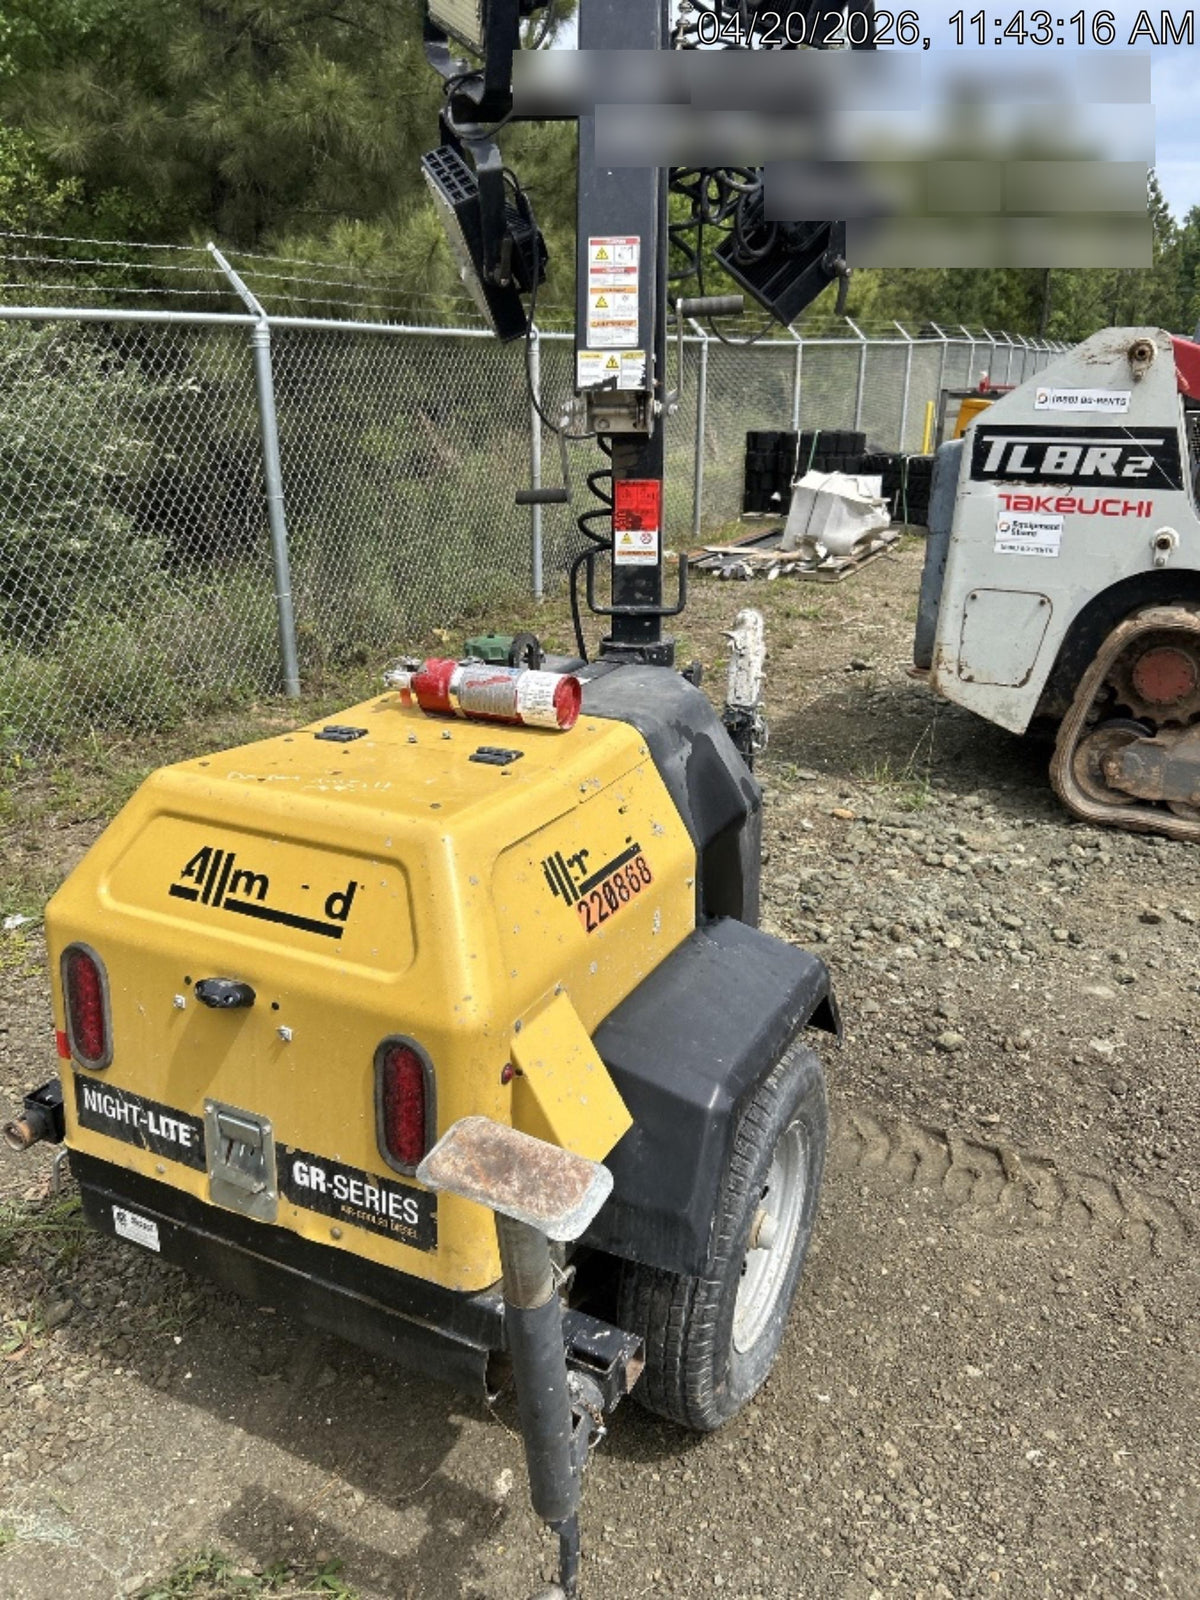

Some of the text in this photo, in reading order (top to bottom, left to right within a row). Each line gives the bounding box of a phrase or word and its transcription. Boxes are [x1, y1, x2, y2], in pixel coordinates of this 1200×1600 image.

[982, 435, 1165, 478] TL8R2
[577, 856, 652, 934] 220868
[83, 1086, 193, 1148] NIGHT-LITE
[292, 1160, 419, 1224] GR-SERIES
